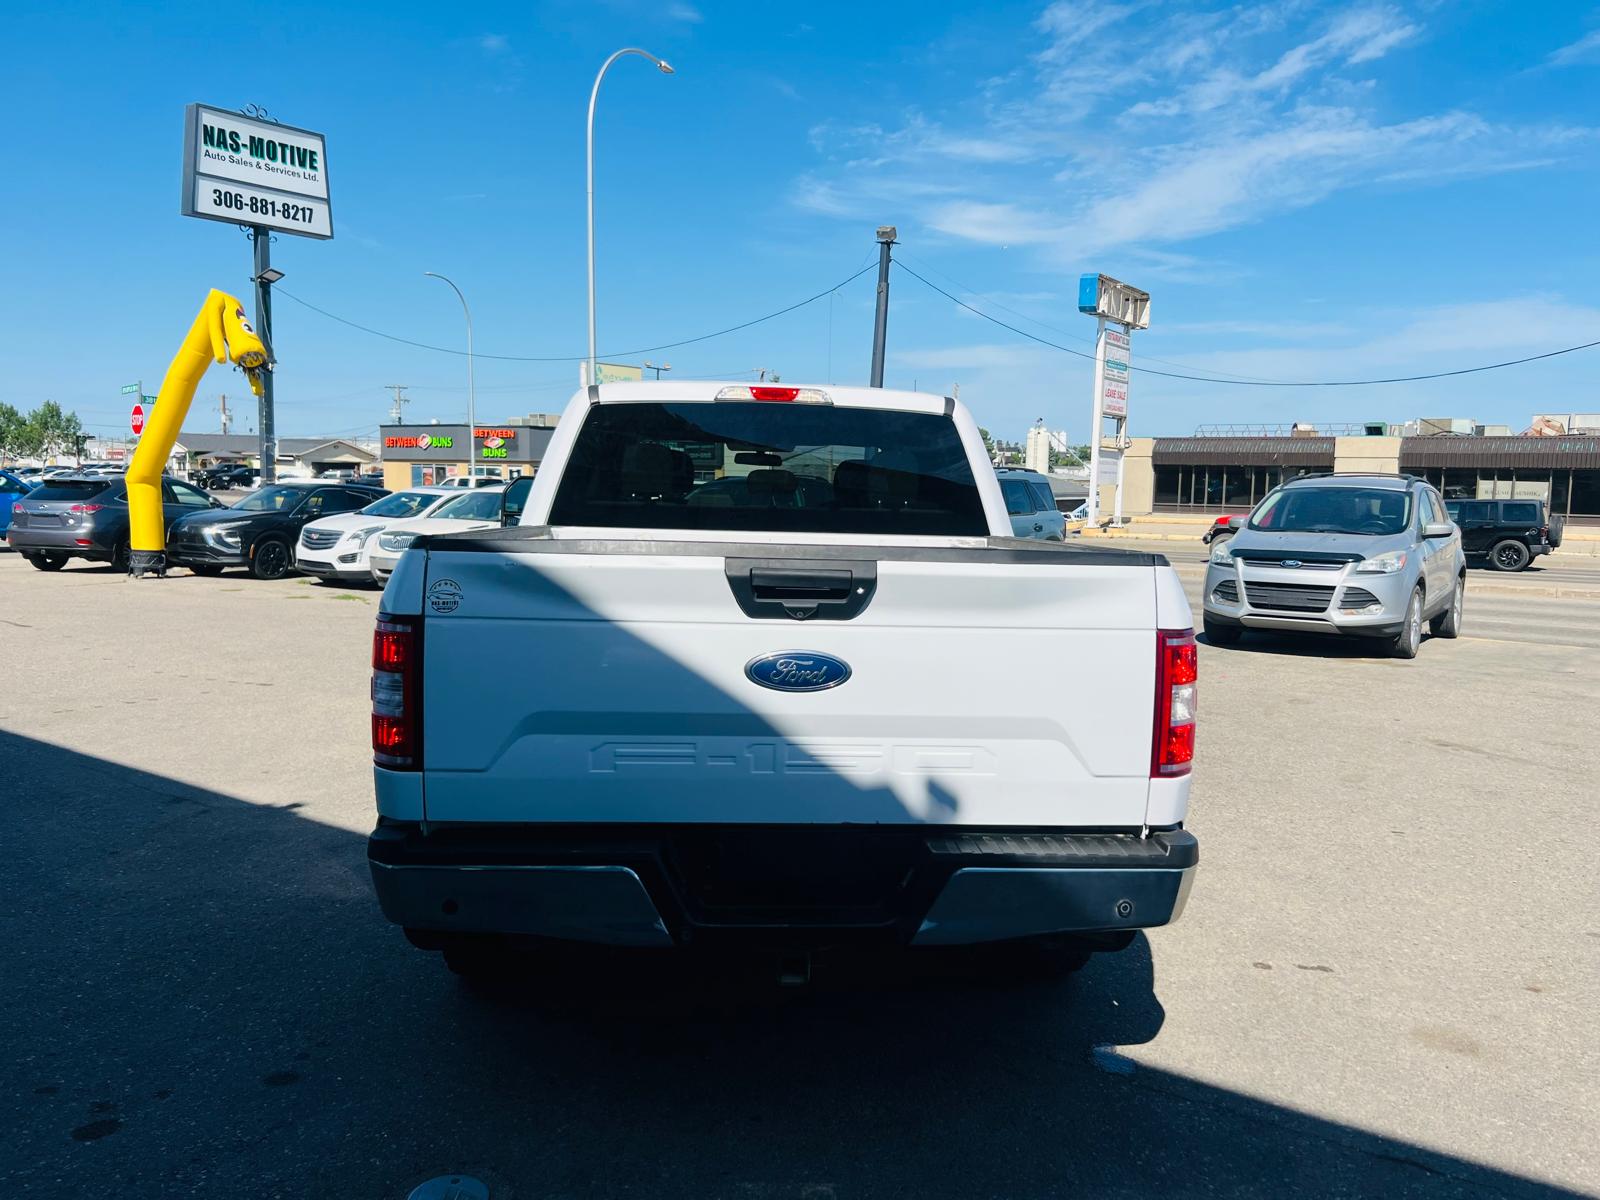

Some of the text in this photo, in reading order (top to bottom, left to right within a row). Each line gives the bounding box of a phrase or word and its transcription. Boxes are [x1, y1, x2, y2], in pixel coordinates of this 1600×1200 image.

[203, 124, 318, 172] NAS-MOTIVE
[204, 149, 319, 183] Auto Sales & Services Ltd.
[213, 189, 313, 223] 306-881-8217
[132, 414, 143, 425] STOP
[385, 437, 453, 448] BETWEEN BUNS
[473, 428, 515, 438] BETWEEN
[483, 448, 507, 458] BUNS
[769, 658, 828, 683] Ford
[588, 742, 998, 776] F-150
